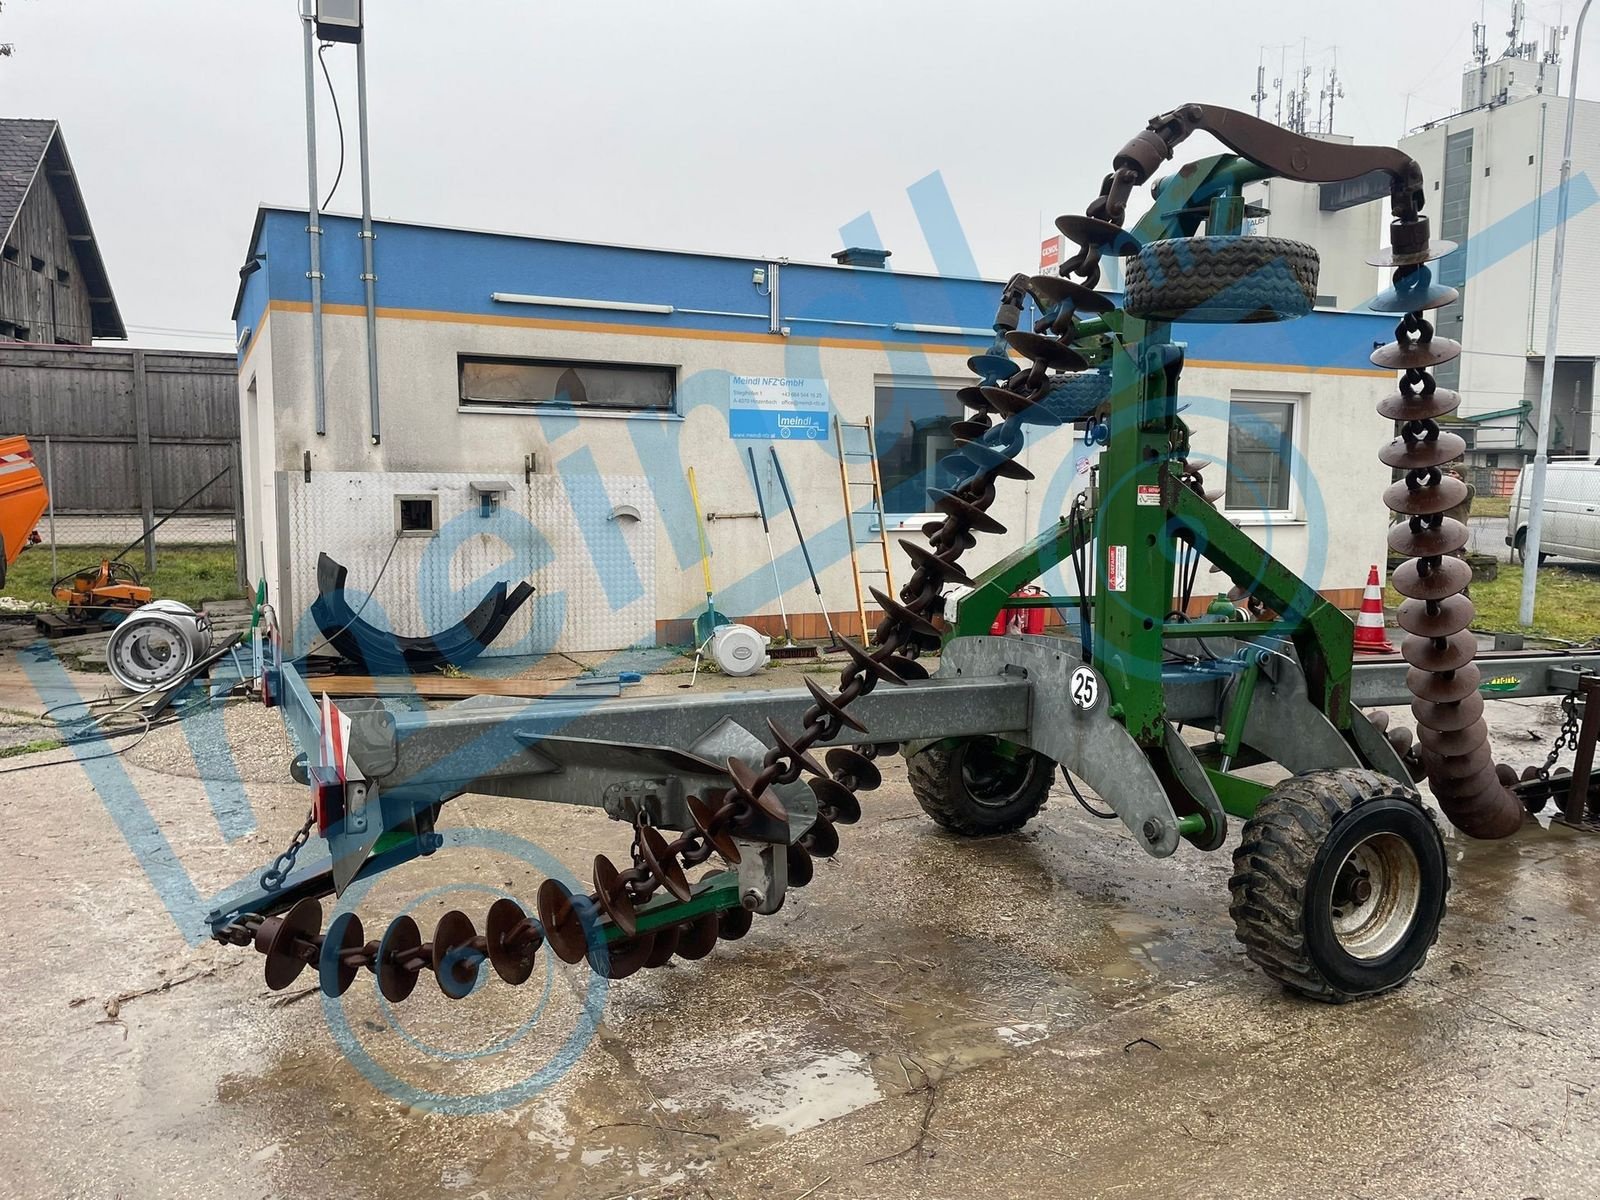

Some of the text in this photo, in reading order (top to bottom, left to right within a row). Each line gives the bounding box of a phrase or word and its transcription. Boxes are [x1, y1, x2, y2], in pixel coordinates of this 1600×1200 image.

[733, 376, 760, 385] Meindl
[780, 378, 804, 387] GmbH
[780, 416, 811, 425] meindl
[1074, 672, 1094, 703] 25
